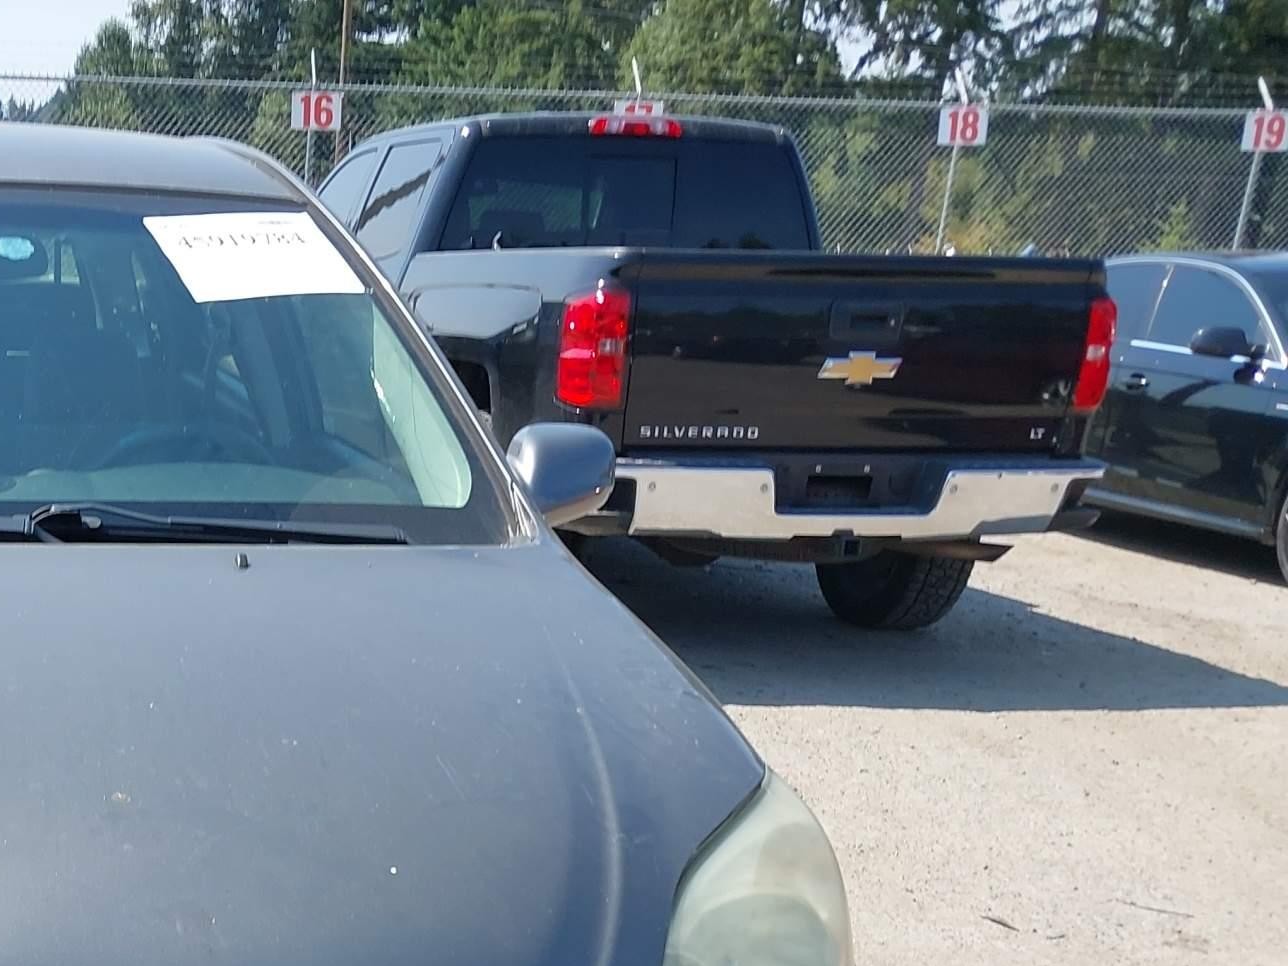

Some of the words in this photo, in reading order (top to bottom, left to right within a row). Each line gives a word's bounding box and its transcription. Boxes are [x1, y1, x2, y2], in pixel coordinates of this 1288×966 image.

[301, 94, 333, 129] 16
[948, 109, 980, 142] 18
[1253, 115, 1286, 149] 19
[640, 425, 759, 439] SILVERADO
[1030, 427, 1045, 440] LT
